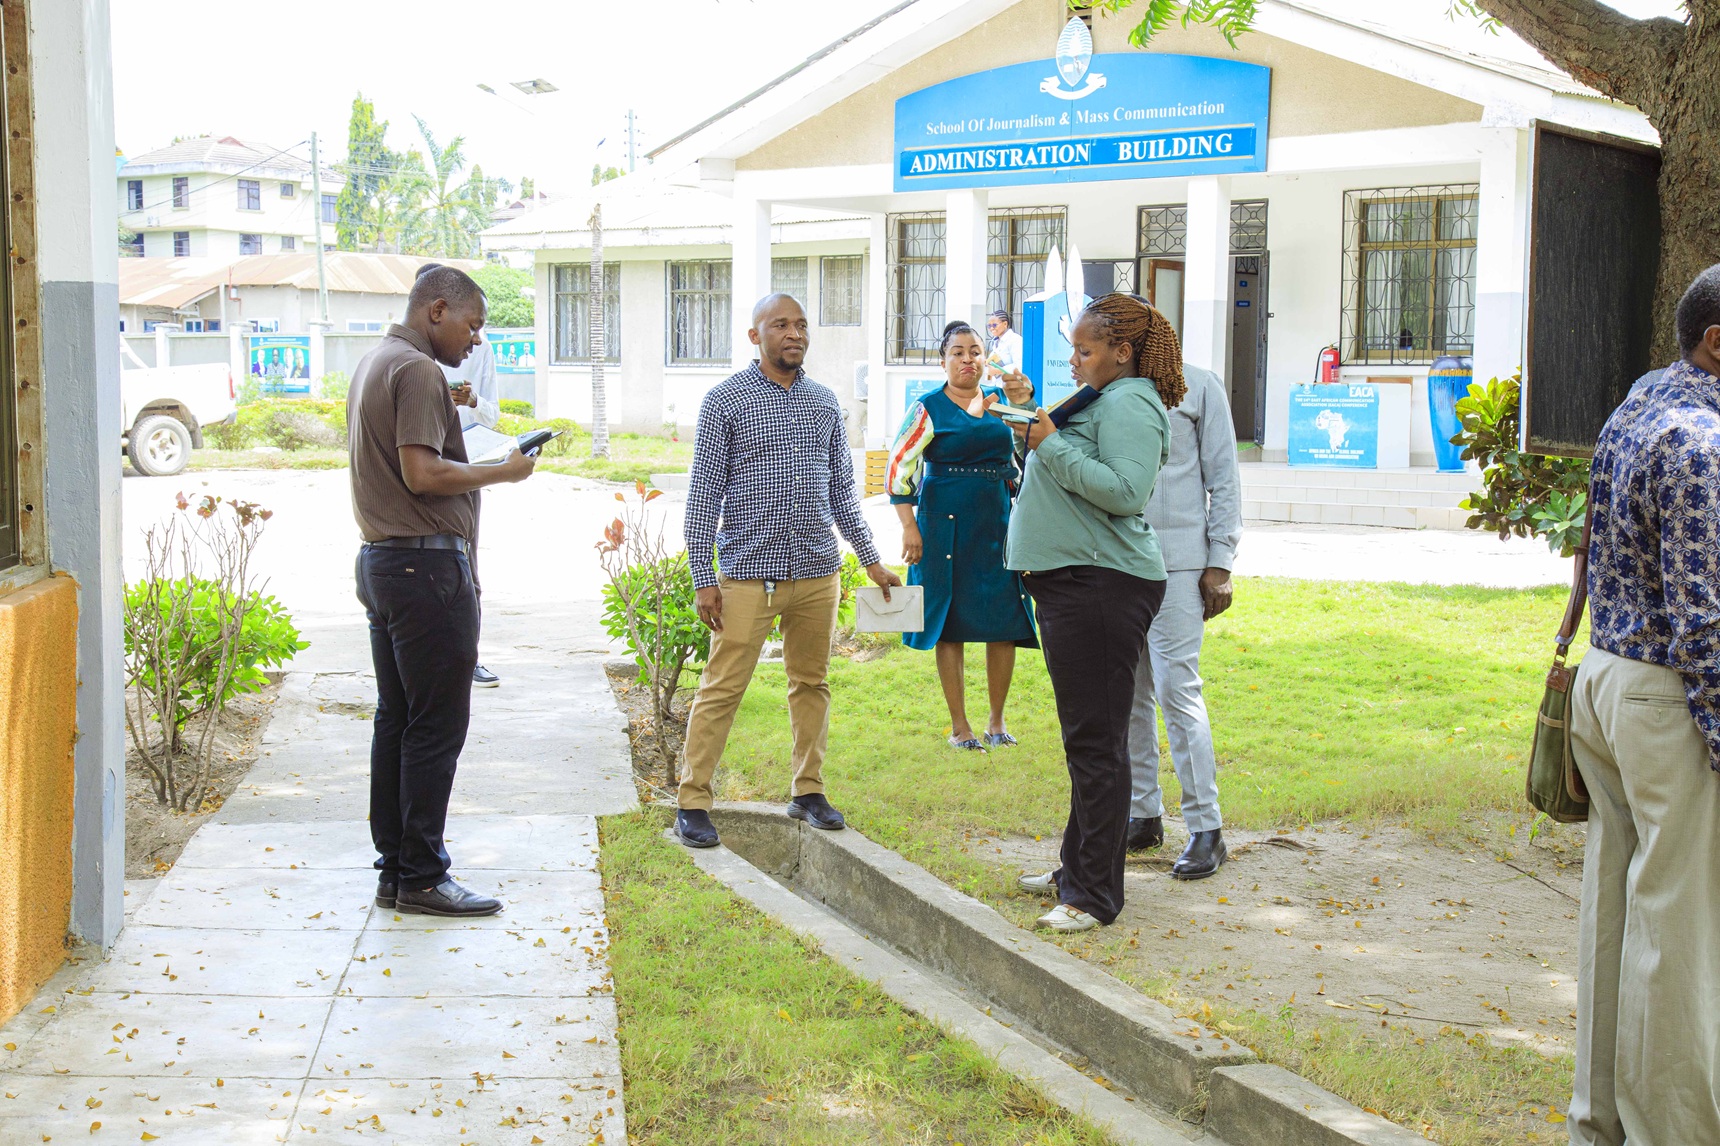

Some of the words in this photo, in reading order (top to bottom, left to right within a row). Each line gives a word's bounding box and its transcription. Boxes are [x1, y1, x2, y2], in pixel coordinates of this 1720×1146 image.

[926, 119, 965, 135] School
[968, 118, 985, 132] Of
[987, 114, 1055, 131] Journalism
[1059, 111, 1070, 126] &
[1075, 110, 1110, 124] Mass
[1113, 100, 1225, 122] Communication
[910, 143, 1091, 173] ADMINISTRATION
[1118, 133, 1233, 161] BUILDING
[1349, 386, 1375, 397] EACA
